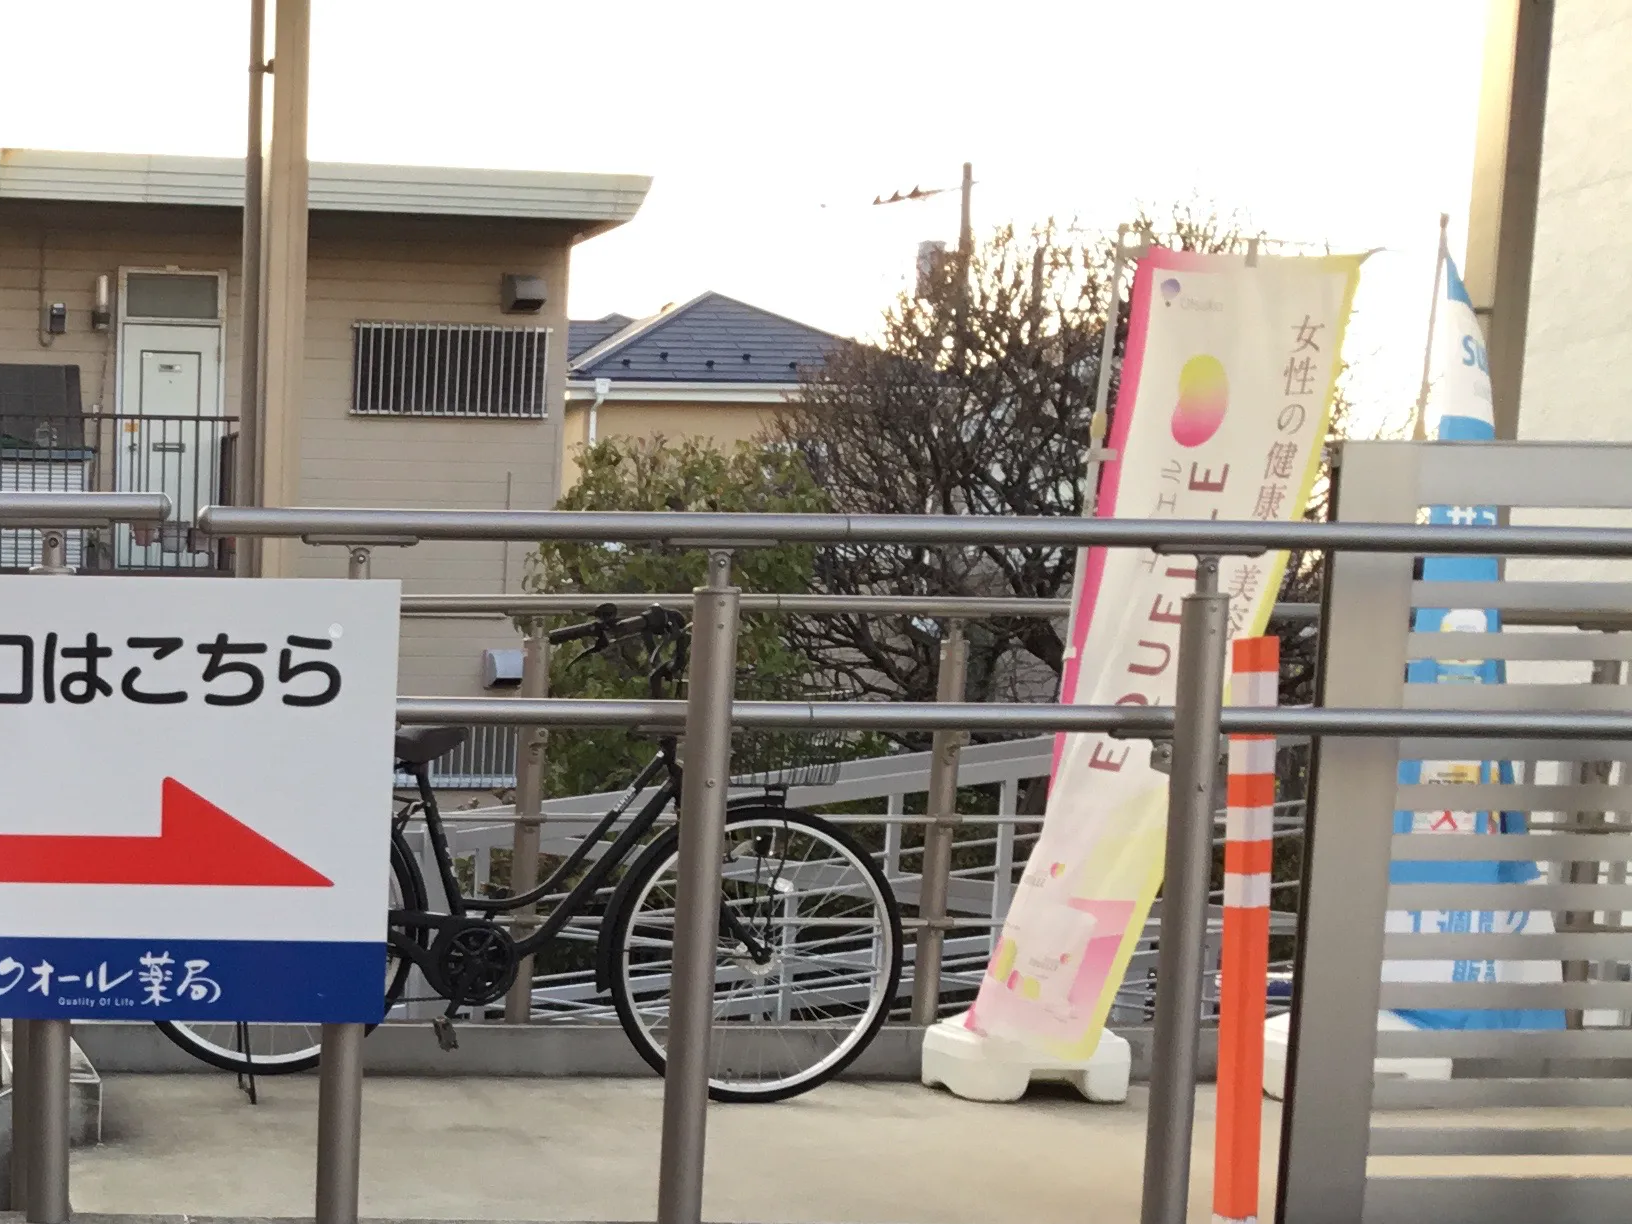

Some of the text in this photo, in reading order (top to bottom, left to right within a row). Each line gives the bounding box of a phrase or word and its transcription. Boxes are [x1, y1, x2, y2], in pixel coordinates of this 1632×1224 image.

[1087, 461, 1231, 773] EUEE
[58, 996, 135, 1008] Quality Of Life
